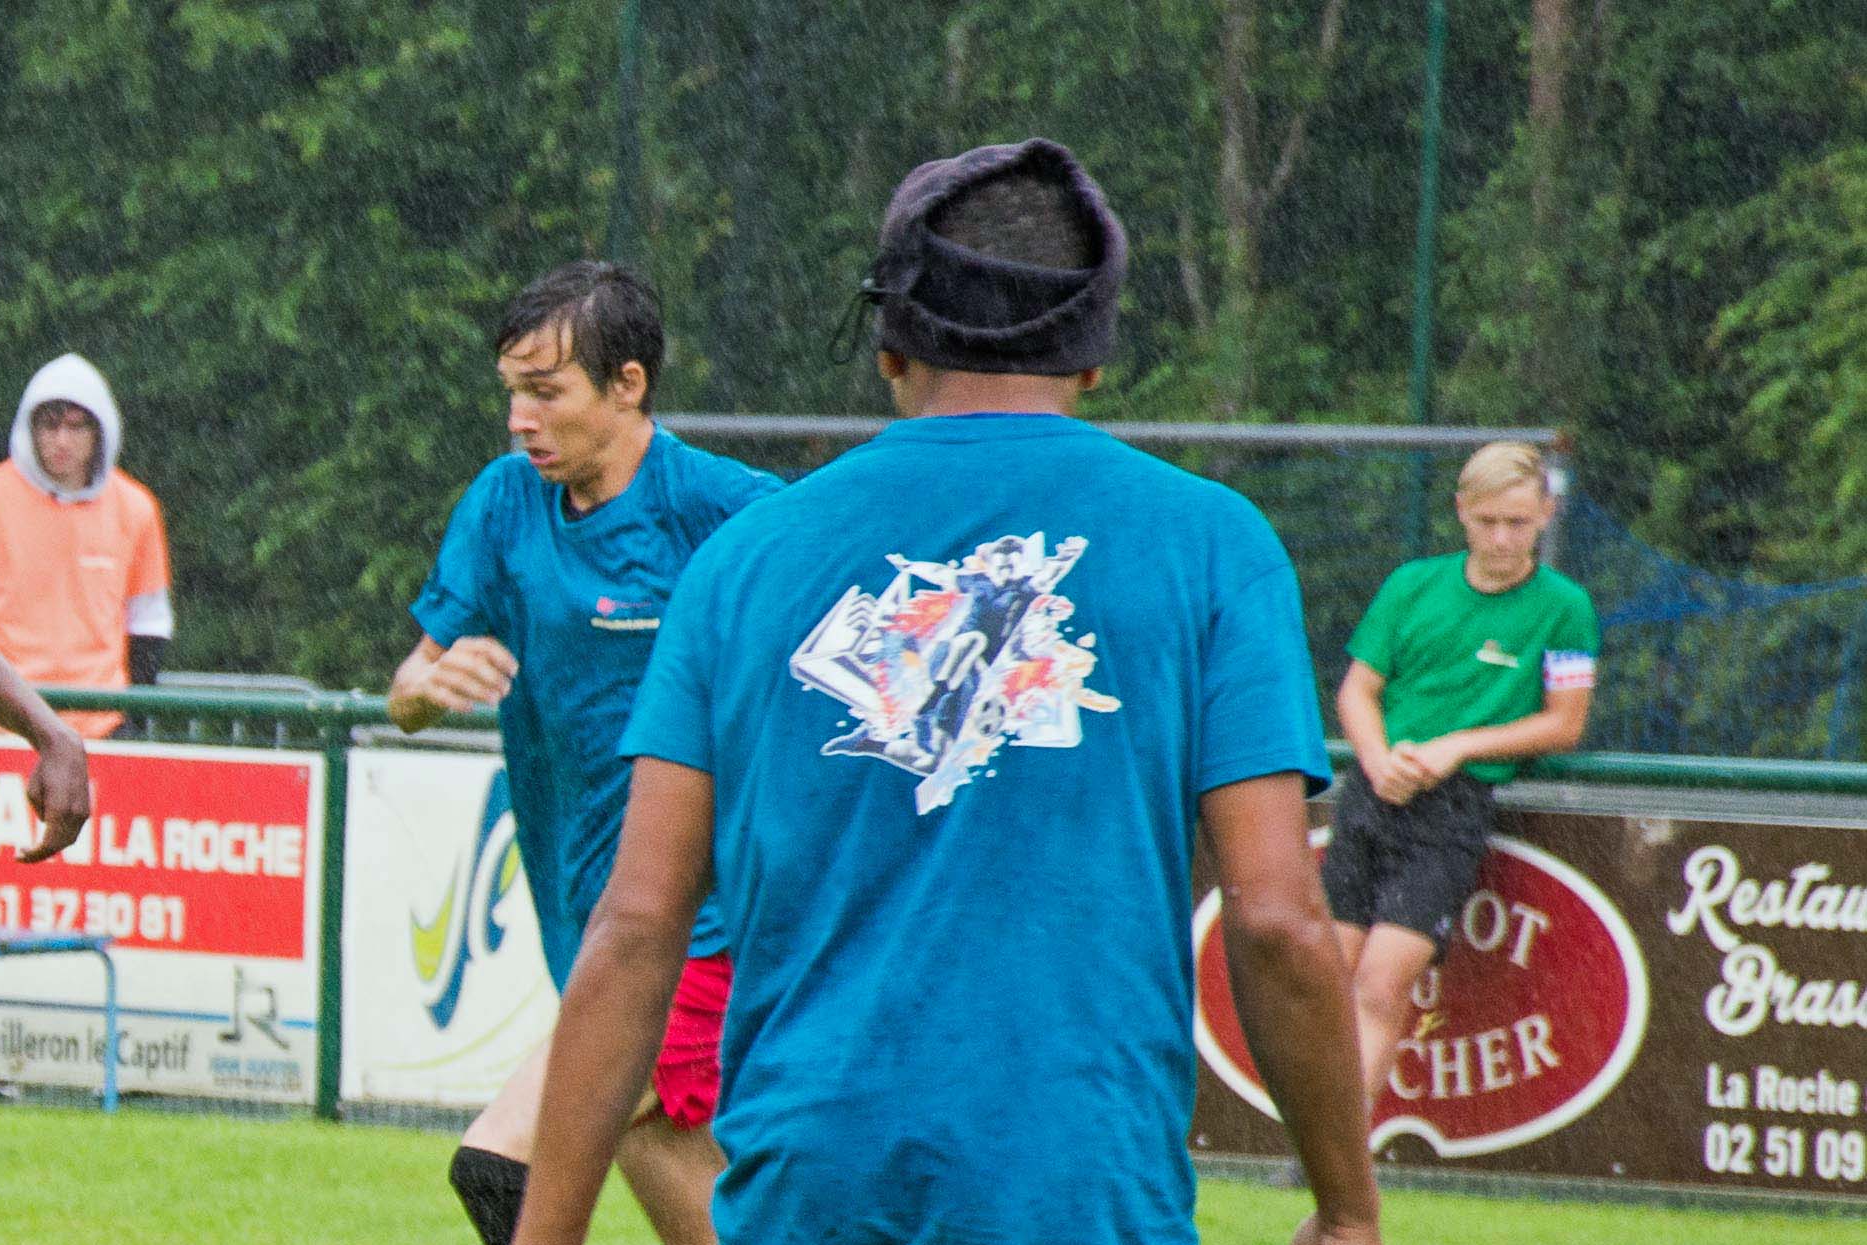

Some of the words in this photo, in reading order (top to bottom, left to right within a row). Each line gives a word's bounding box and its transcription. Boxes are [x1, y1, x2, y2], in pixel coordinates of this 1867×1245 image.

[99, 813, 156, 868] LA
[163, 818, 302, 878] ROCHE
[30, 886, 78, 934] 37
[84, 889, 130, 938] 30
[138, 894, 185, 943] 81
[116, 1029, 192, 1078] Captif
[1387, 1013, 1560, 1100] CHER
[1707, 1062, 1749, 1109] La
[1755, 1064, 1860, 1117] Roche
[1705, 1120, 1755, 1175] 02
[1764, 1126, 1804, 1178] 51
[1815, 1128, 1866, 1182] 09
